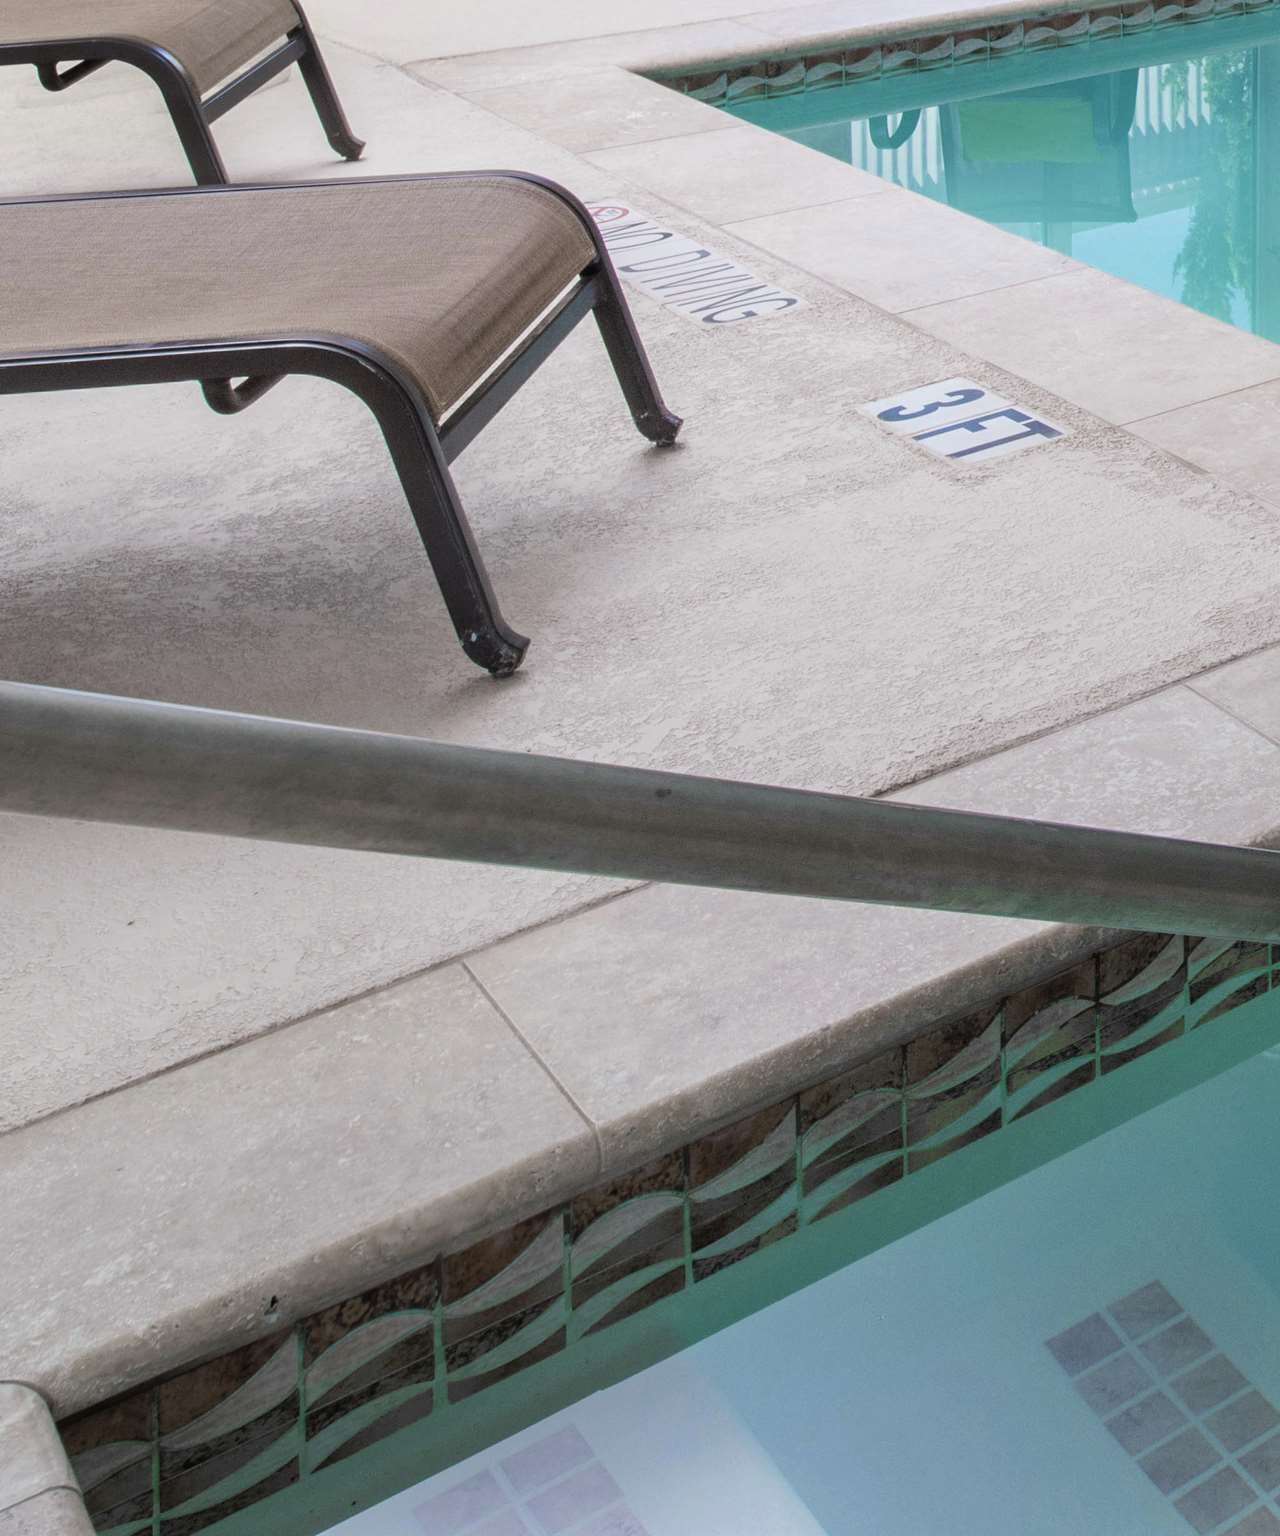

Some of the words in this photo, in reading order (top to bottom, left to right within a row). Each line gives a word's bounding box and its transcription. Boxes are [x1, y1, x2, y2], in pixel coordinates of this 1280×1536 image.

[600, 221, 673, 252] NO
[618, 249, 799, 325] DIVING
[877, 388, 985, 423] 3
[912, 407, 1065, 460] FT
